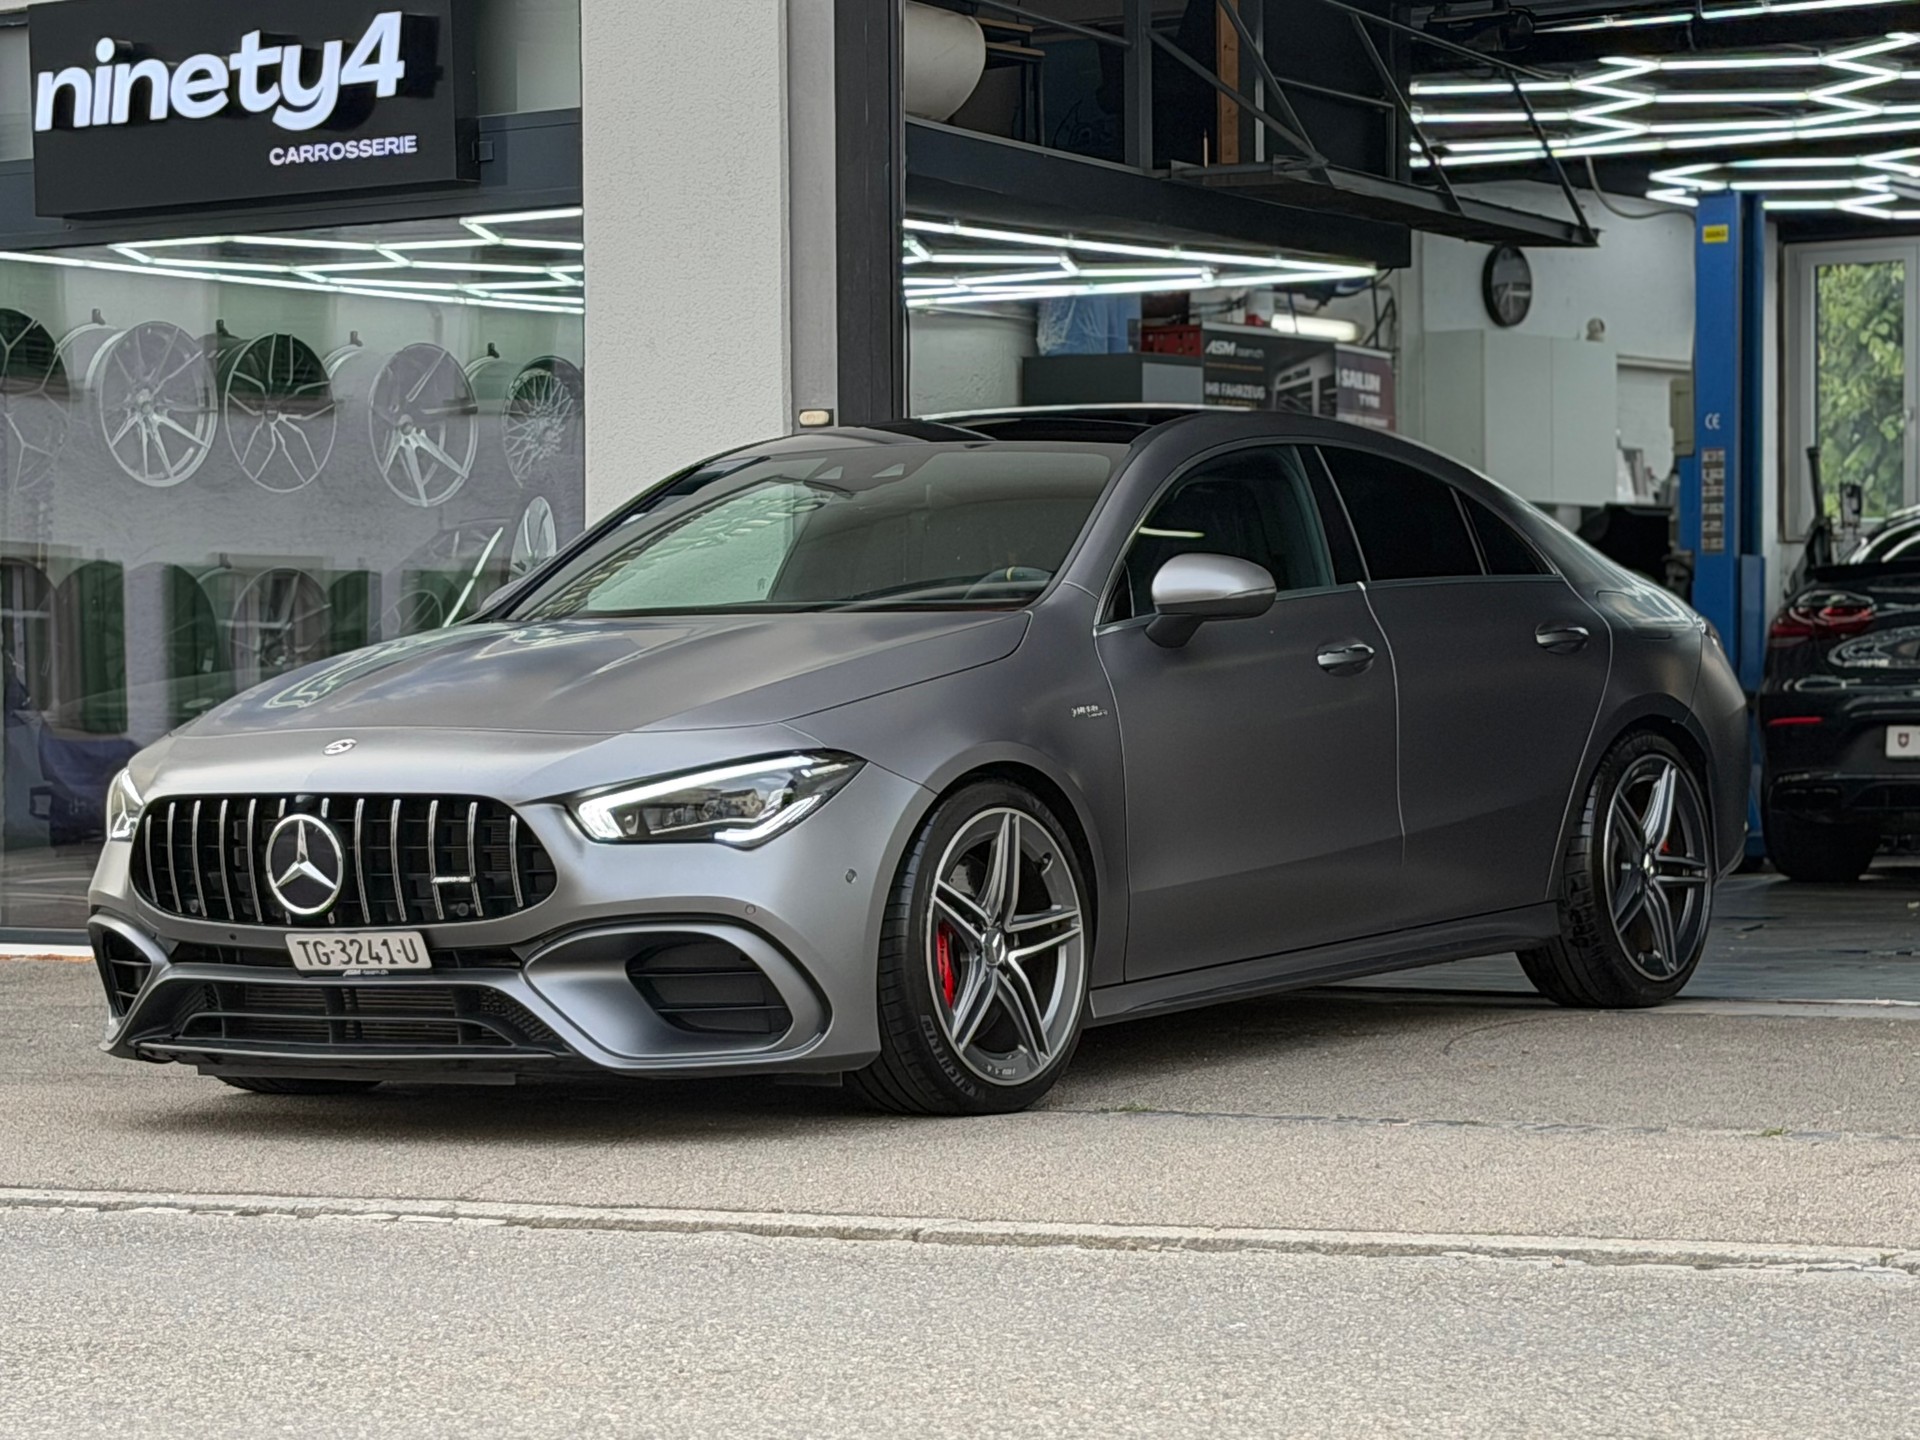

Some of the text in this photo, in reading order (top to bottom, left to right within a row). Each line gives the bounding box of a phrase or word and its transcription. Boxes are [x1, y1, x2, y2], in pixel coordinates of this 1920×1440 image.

[34, 11, 405, 132] ninety4
[269, 134, 418, 166] CARROSSERIE
[1205, 339, 1236, 356] ASM
